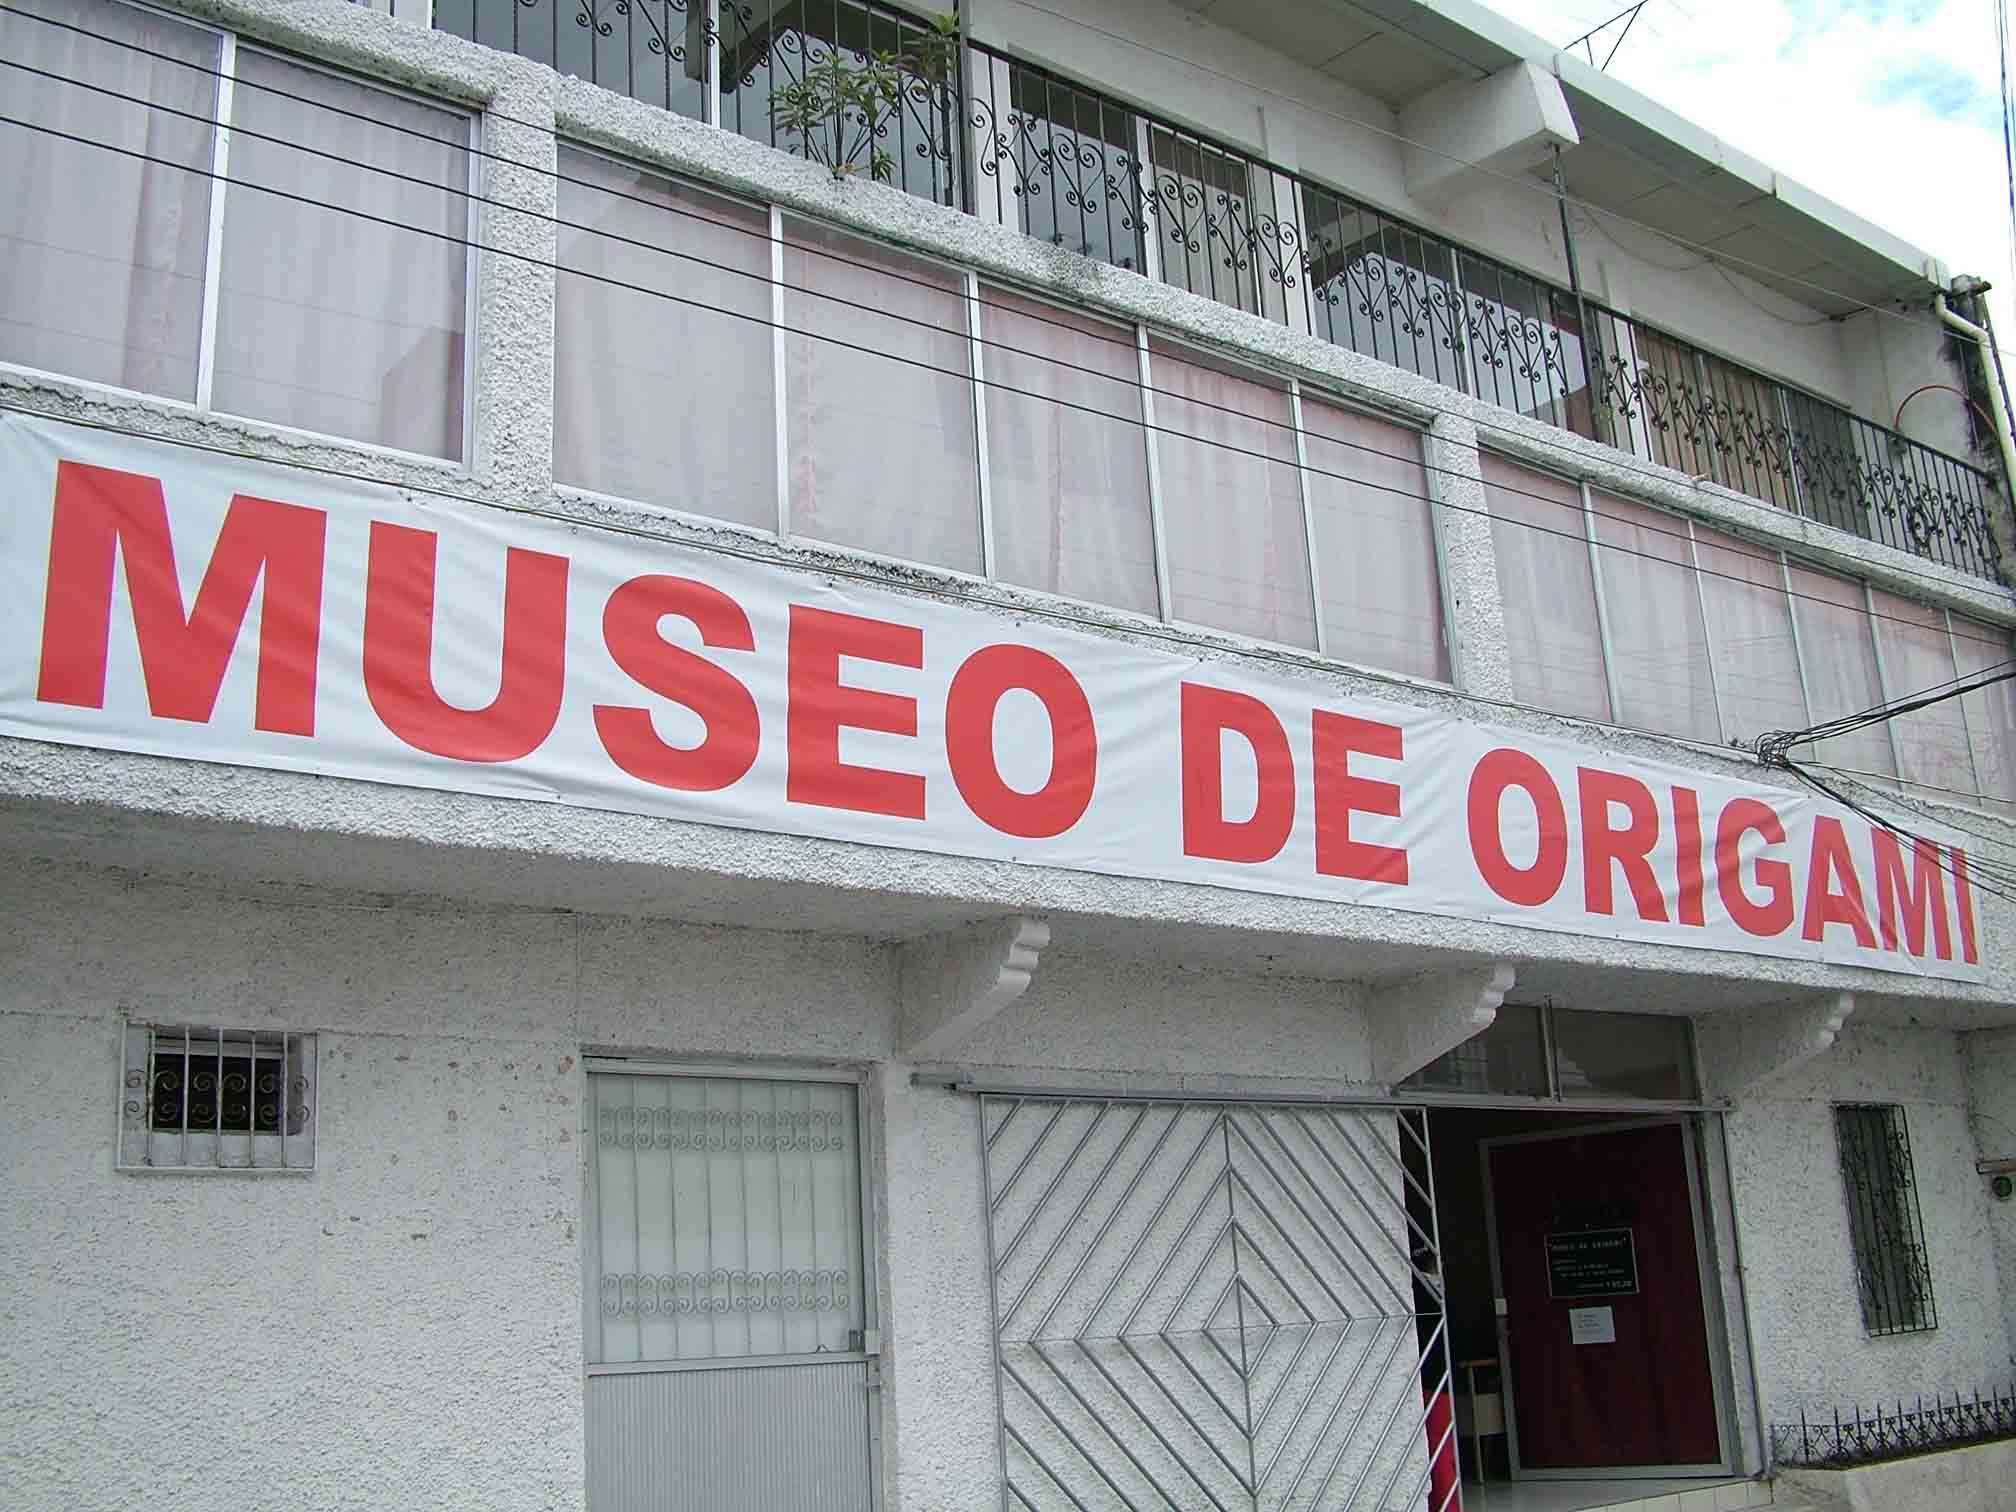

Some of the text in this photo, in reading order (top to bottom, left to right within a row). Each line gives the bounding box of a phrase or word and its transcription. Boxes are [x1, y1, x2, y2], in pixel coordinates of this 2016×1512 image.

[38, 461, 1978, 964] MUSEO DE ORIGAMI
